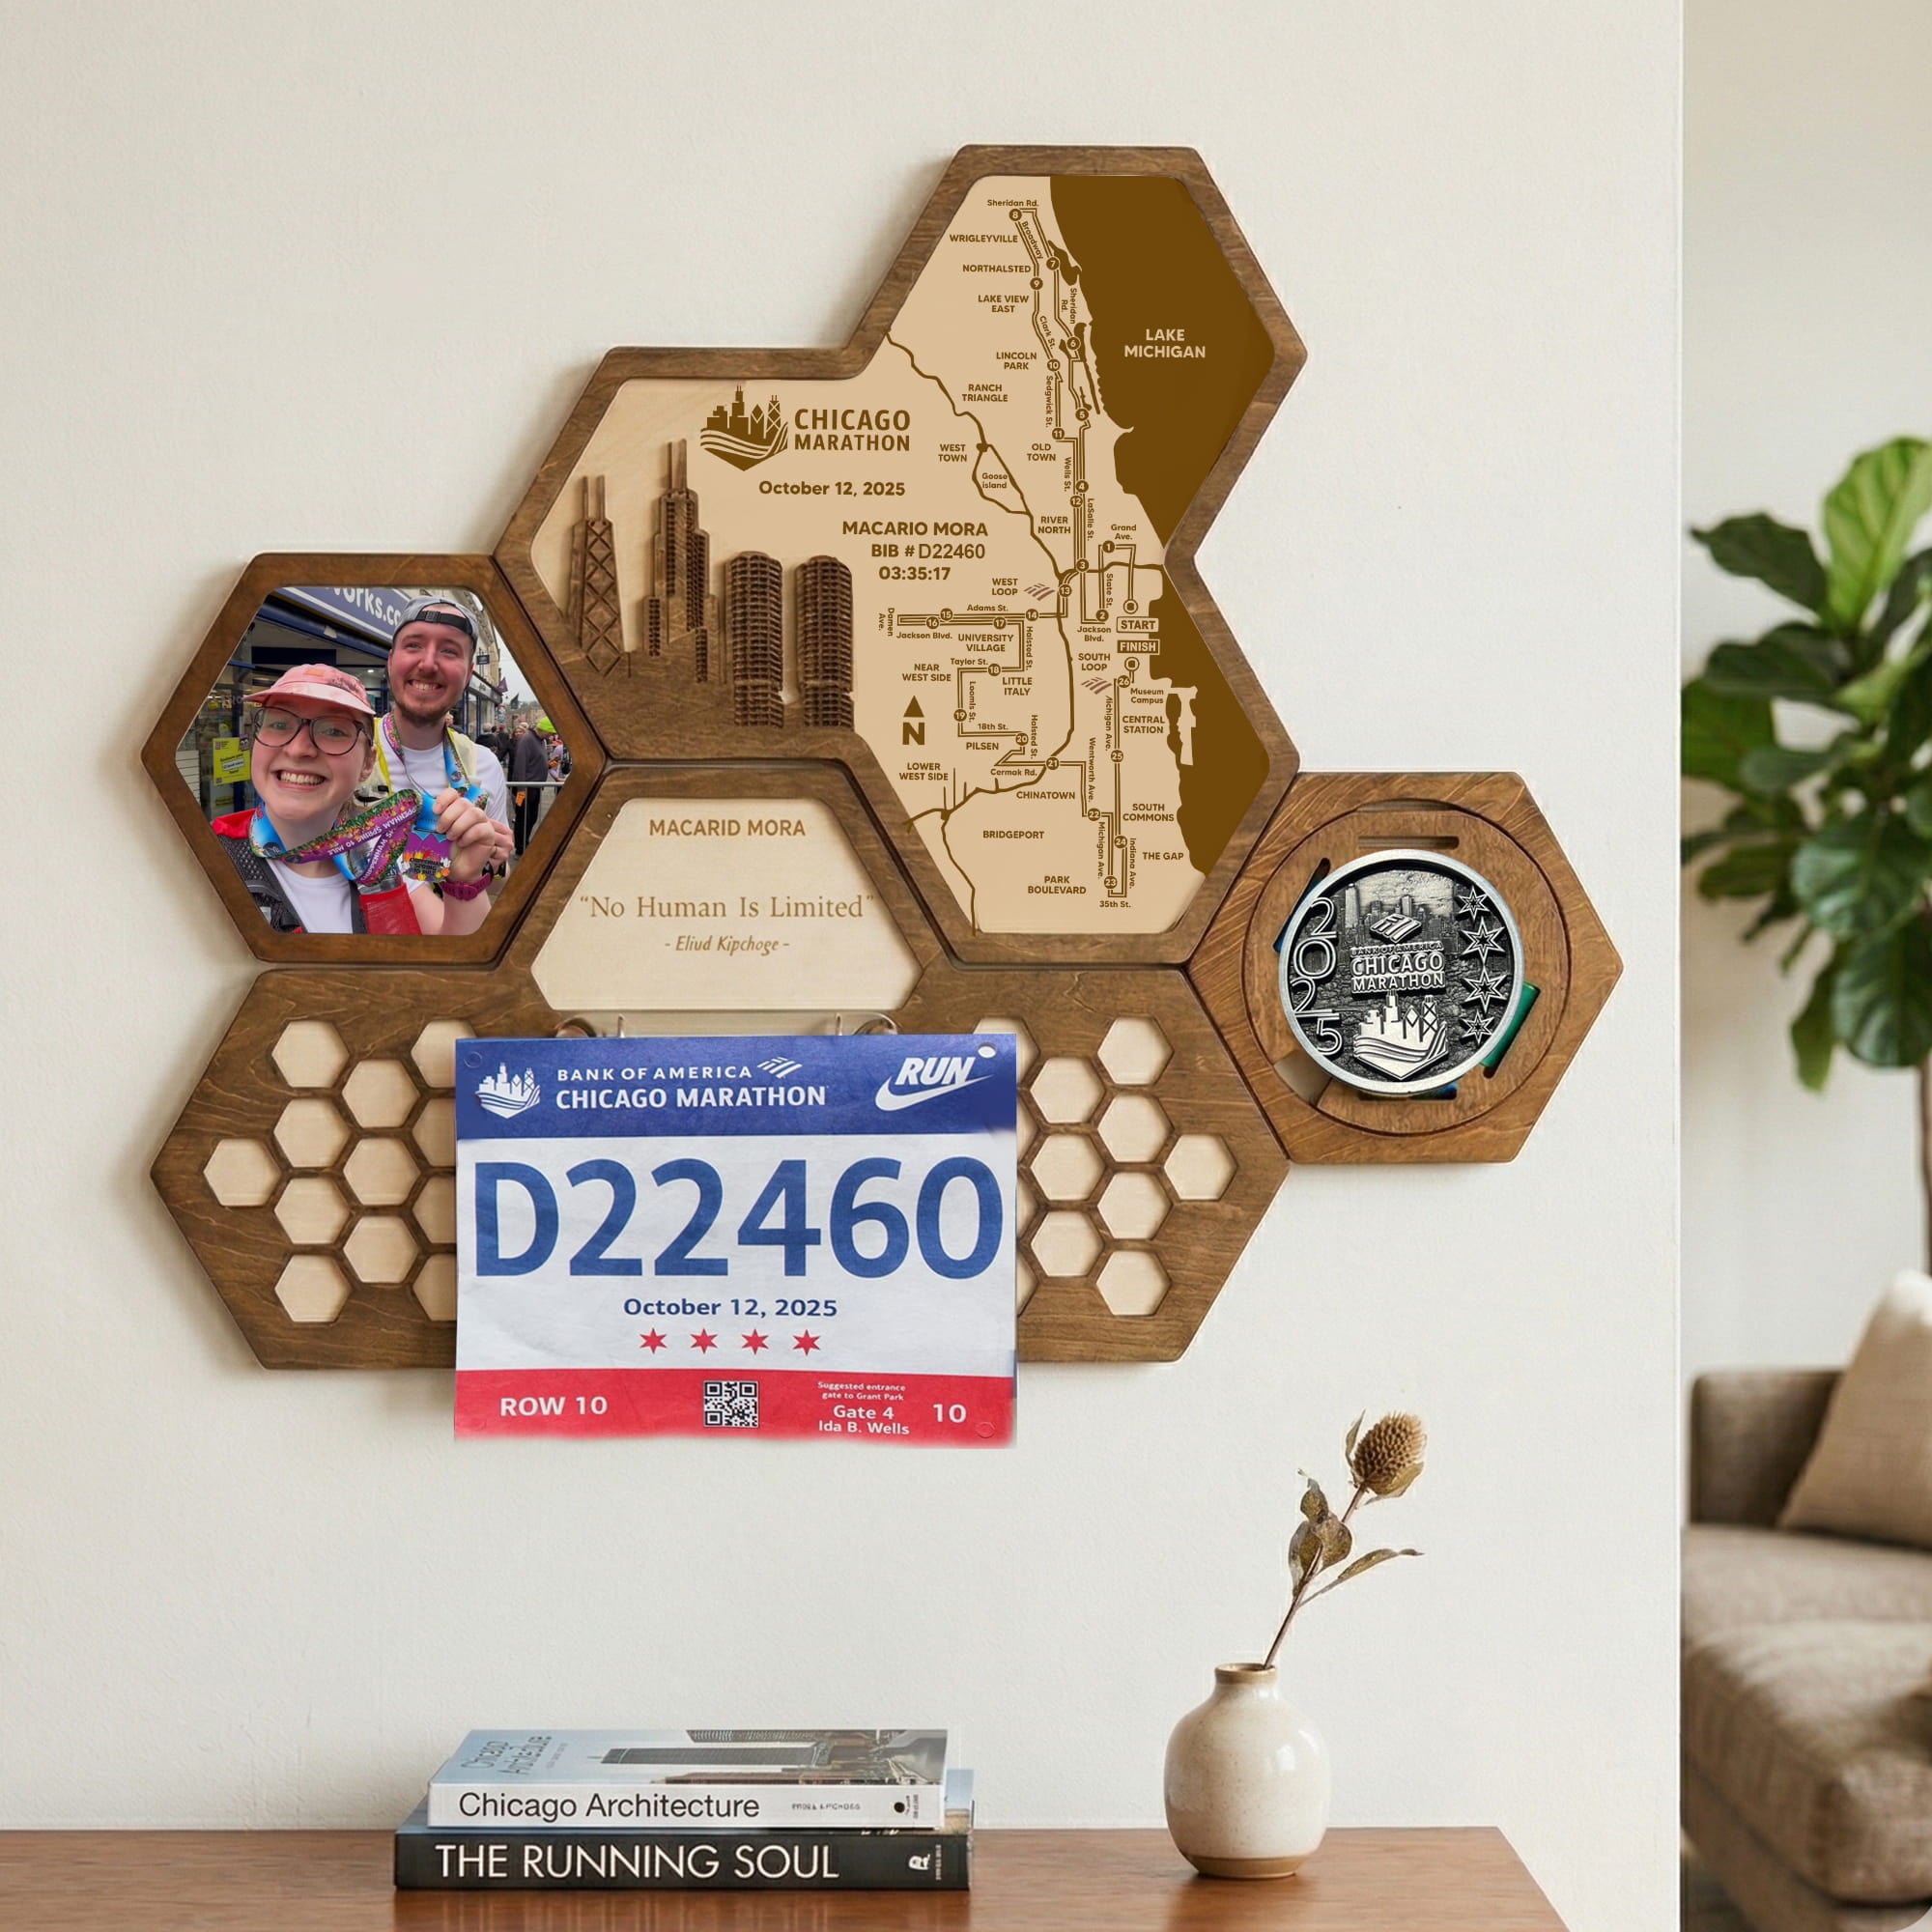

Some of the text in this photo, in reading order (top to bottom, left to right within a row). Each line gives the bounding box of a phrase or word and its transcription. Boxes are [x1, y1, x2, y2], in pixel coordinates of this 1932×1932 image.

[1021, 221, 1043, 259] Broadway
[979, 295, 1029, 303] LAKE VIEW
[1039, 315, 1052, 336] Clark
[1146, 328, 1184, 341] LAKE
[1124, 345, 1206, 357] MICHIGAN
[794, 408, 910, 432] CHICAGO
[794, 434, 910, 452] MARATHON
[1064, 457, 1072, 479] Wells
[758, 481, 905, 497] October 12, 2025
[842, 521, 988, 536] MACARIO MORA
[871, 544, 899, 557] BIB
[879, 566, 951, 581] 03:35:17
[1121, 620, 1155, 629] START
[958, 634, 1014, 642] UNIVERSITY
[1120, 642, 1156, 652] FINISH
[902, 722, 925, 745] N
[1122, 725, 1164, 734] STATION
[1088, 737, 1096, 782] Wentworth
[649, 819, 806, 837] MACARID MORA
[1097, 821, 1106, 860] Michigan
[580, 895, 874, 918] “No Human Is Limited”
[676, 935, 779, 955] Eliud Kipchoge
[1395, 942, 1443, 952] AMERICA
[1352, 952, 1443, 975] CHICAGO
[1290, 896, 1343, 1056] 2025
[1353, 973, 1443, 990] MARATHON
[557, 1065, 752, 1082] BANK OF AMERICA
[895, 1056, 977, 1087] RUN
[555, 1086, 826, 1109] CHICAGO MARATHON
[473, 1155, 1004, 1279] D22460
[623, 1297, 838, 1319] October 12, 2025
[817, 1381, 865, 1391] Suggested
[856, 1392, 881, 1401] Grant
[499, 1396, 609, 1417] ROW 10
[833, 1405, 894, 1419] Gate 4
[932, 1404, 966, 1423] 10
[818, 1420, 910, 1435] Ida B. Wells
[458, 1792, 760, 1820] Chicago Architecture
[435, 1844, 839, 1879] THE RUNNING SOUL
